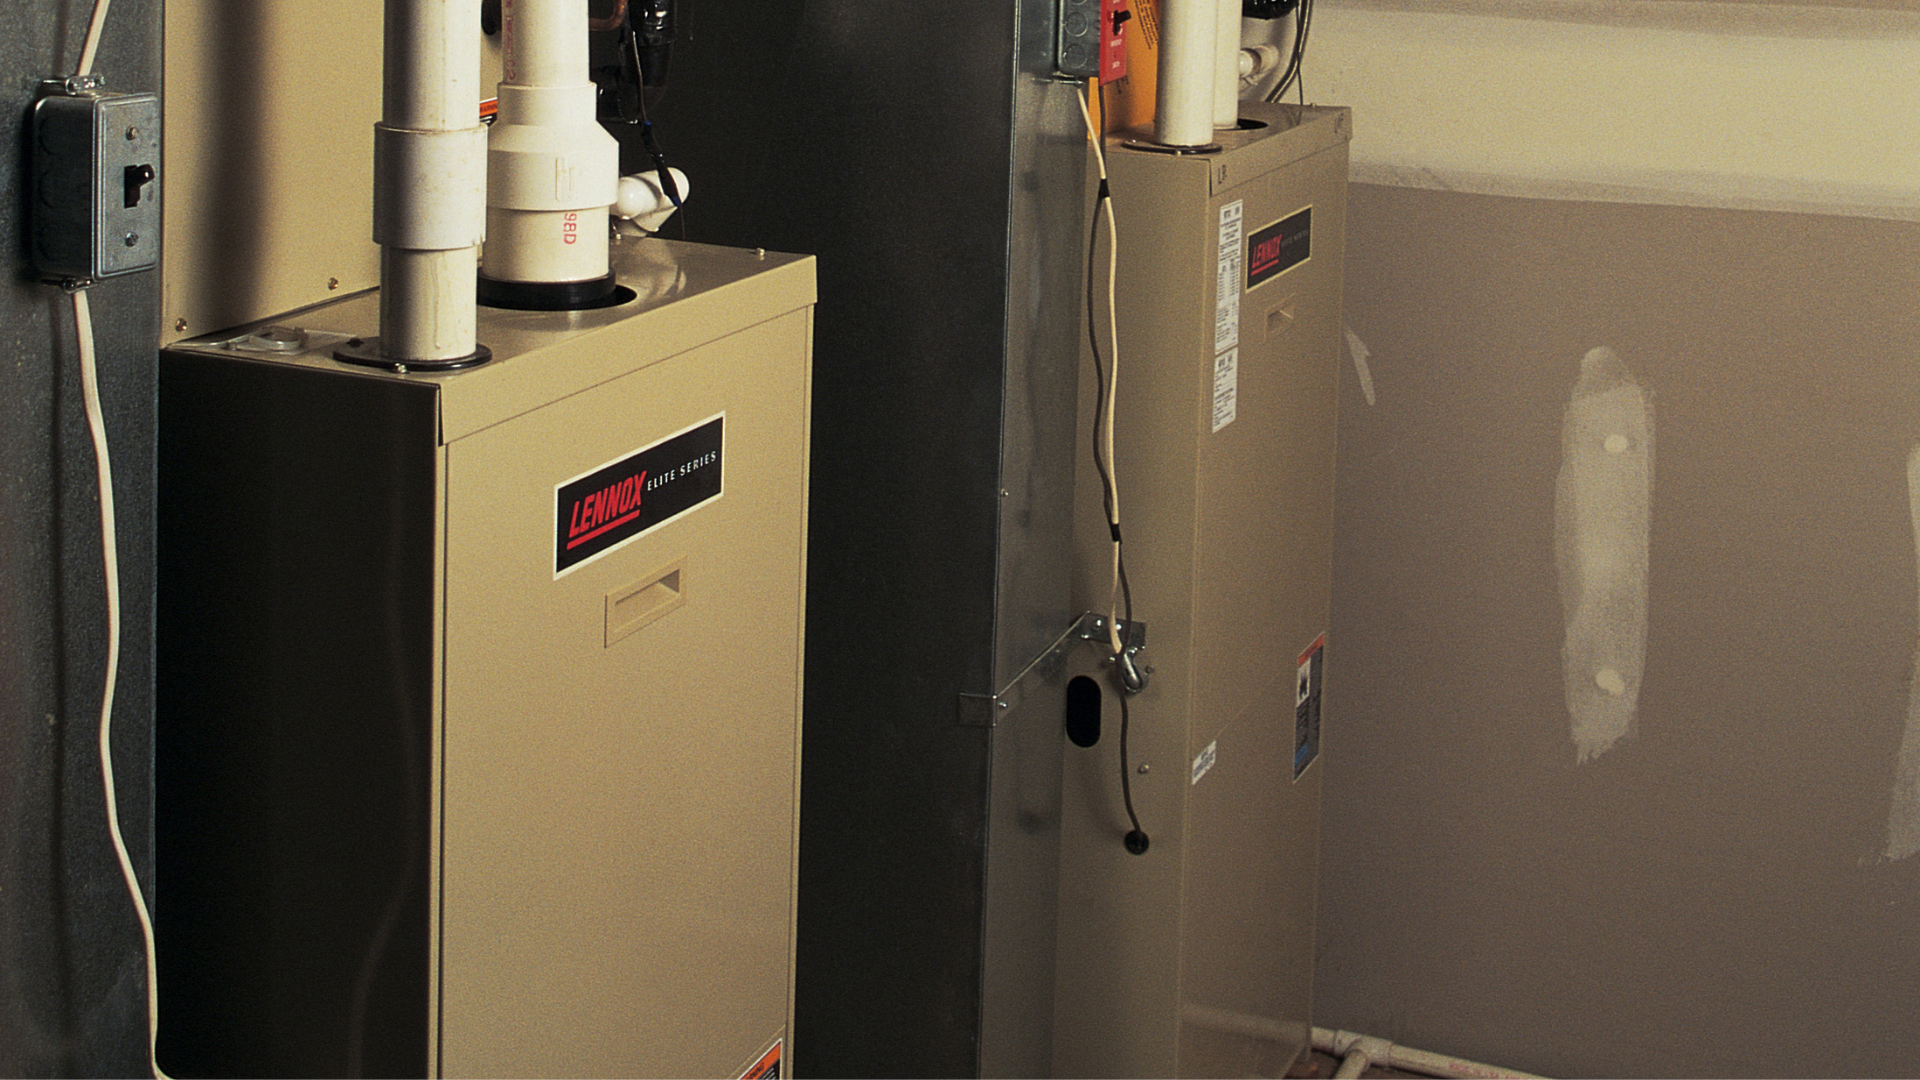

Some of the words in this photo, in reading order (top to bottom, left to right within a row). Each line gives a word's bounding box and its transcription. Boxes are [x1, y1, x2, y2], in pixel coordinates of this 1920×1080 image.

[568, 470, 647, 539] LENNOX
[647, 469, 675, 491] ELITE
[680, 450, 717, 476] SERIES
